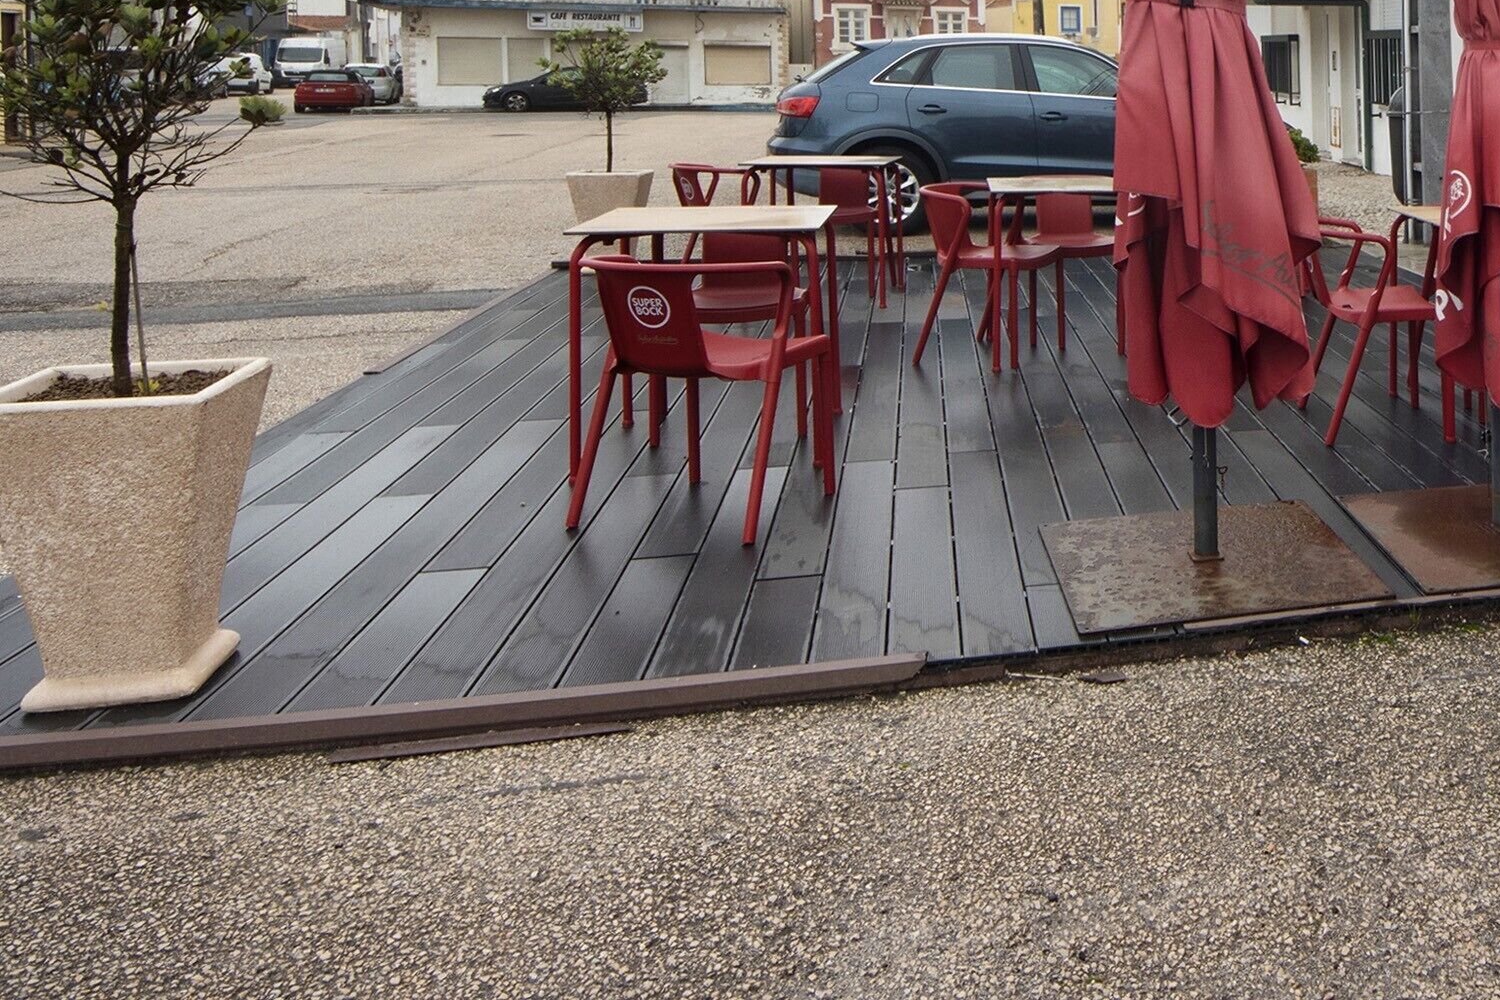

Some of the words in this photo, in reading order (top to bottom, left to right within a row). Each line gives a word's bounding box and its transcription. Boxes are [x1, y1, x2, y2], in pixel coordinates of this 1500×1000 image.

[572, 12, 620, 21] RESTAURANTE
[631, 297, 663, 307] SUPER
[636, 306, 664, 316] BOCK
